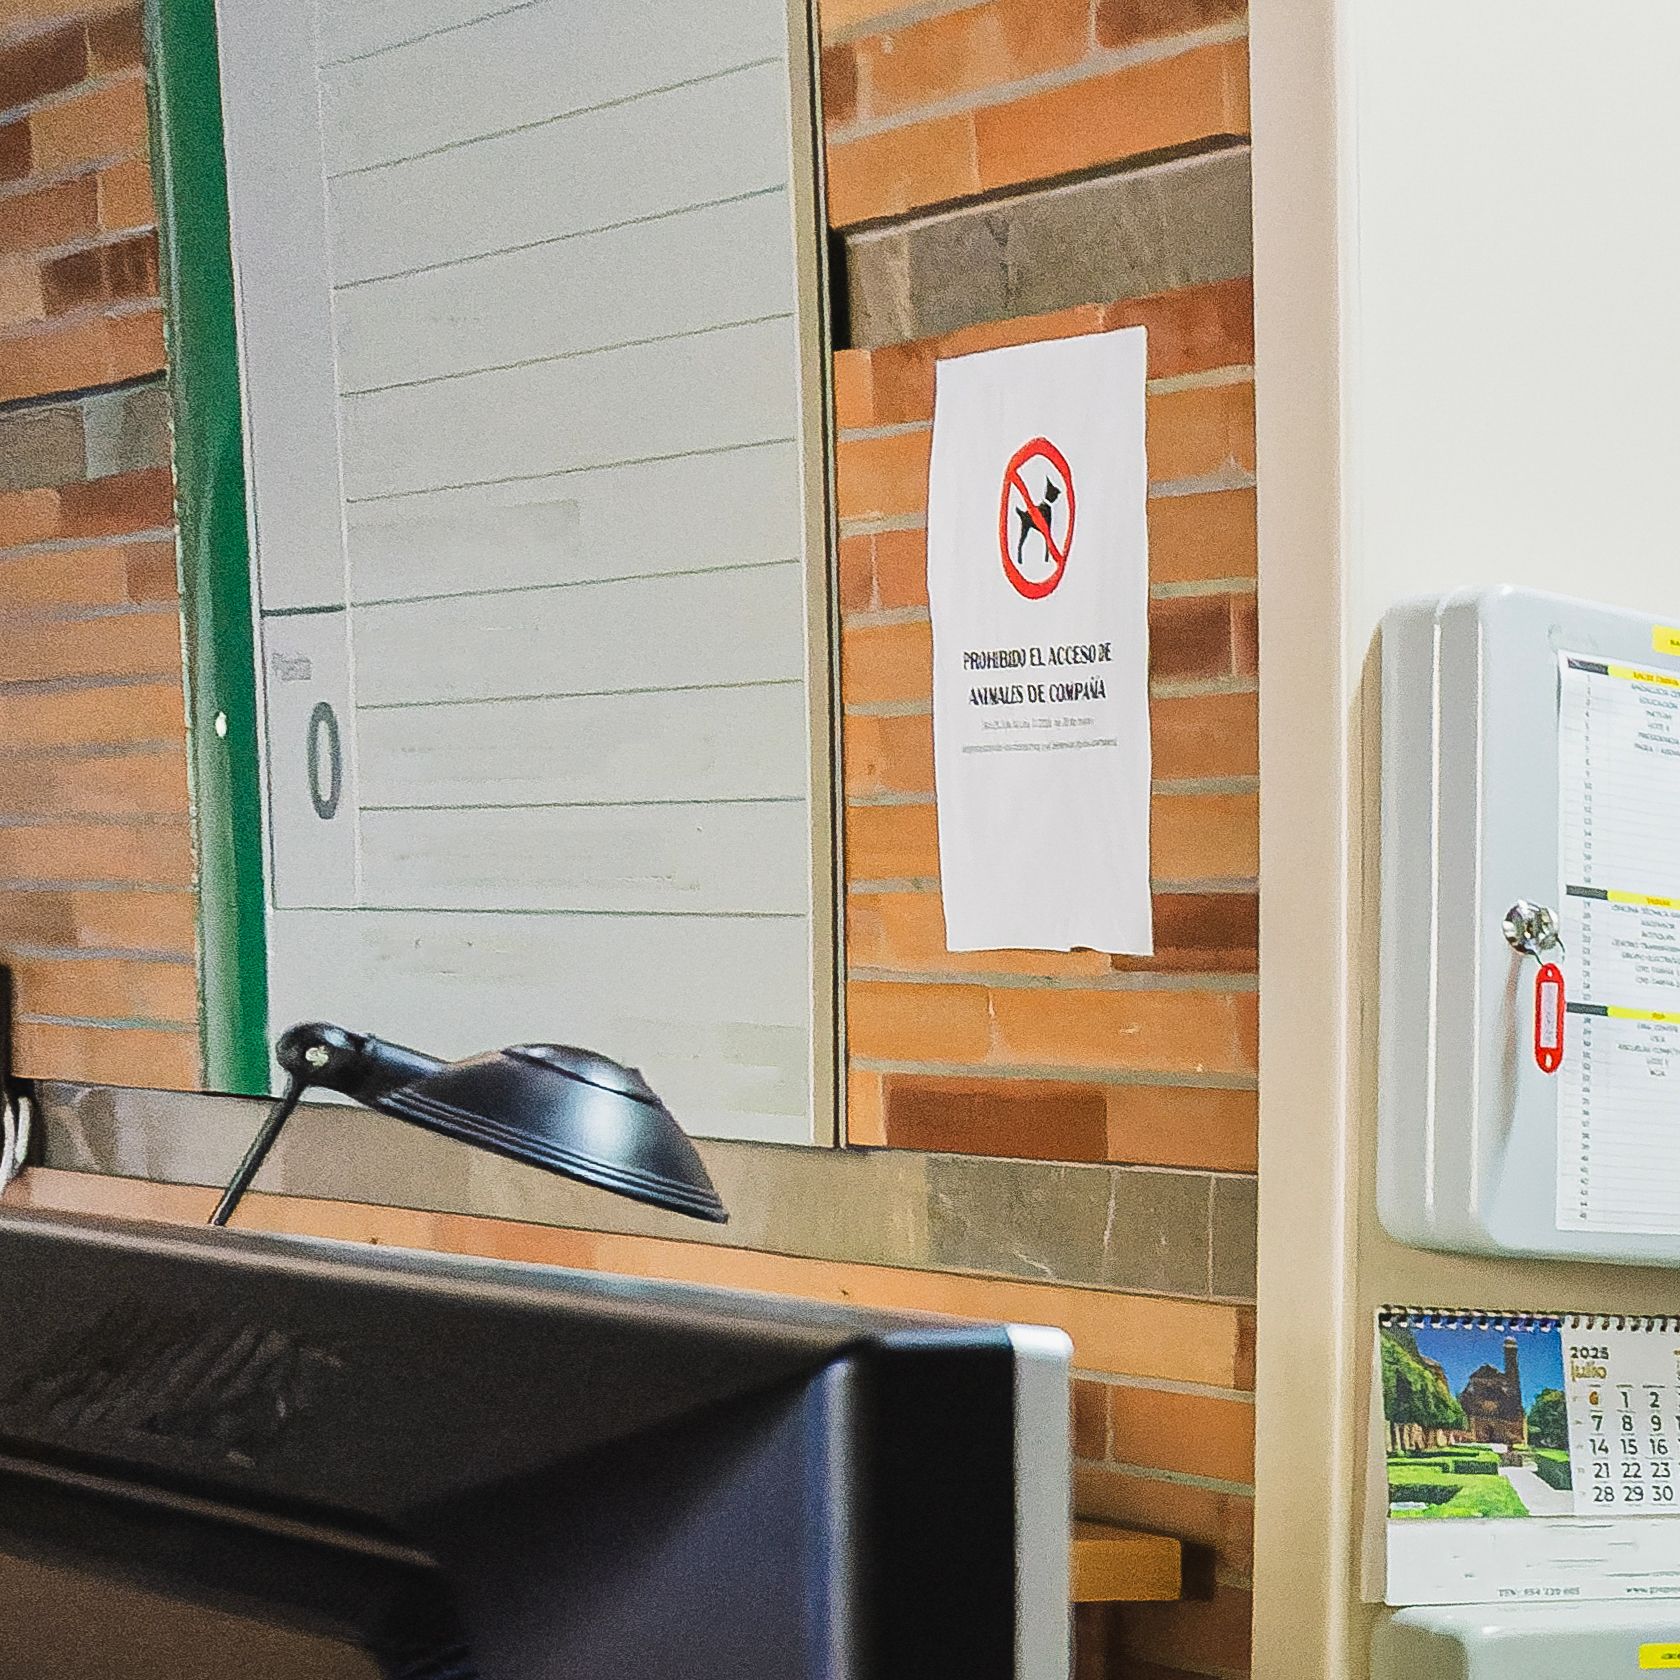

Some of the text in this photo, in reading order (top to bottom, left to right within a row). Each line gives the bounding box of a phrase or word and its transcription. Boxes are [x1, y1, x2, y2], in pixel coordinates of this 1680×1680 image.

[963, 642, 1112, 671] PROHIBIDO EL ACCESO DE
[969, 684, 1024, 706] ANIMALES
[1027, 684, 1046, 703] DE
[1569, 1346, 1610, 1360] 2025
[1621, 1391, 1628, 1408] 1
[1650, 1391, 1660, 1408] 2
[1591, 1415, 1603, 1431] 7
[1621, 1415, 1633, 1432] 8
[1651, 1415, 1662, 1432] 9
[1590, 1438, 1609, 1455] 14
[1620, 1438, 1638, 1455] 15
[1650, 1438, 1668, 1455] 16
[1592, 1462, 1610, 1479] 21
[1622, 1462, 1642, 1478] 22
[1651, 1462, 1671, 1478] 23
[1592, 1485, 1614, 1502] 28
[1623, 1485, 1644, 1501] 29
[1652, 1485, 1673, 1501] 30
